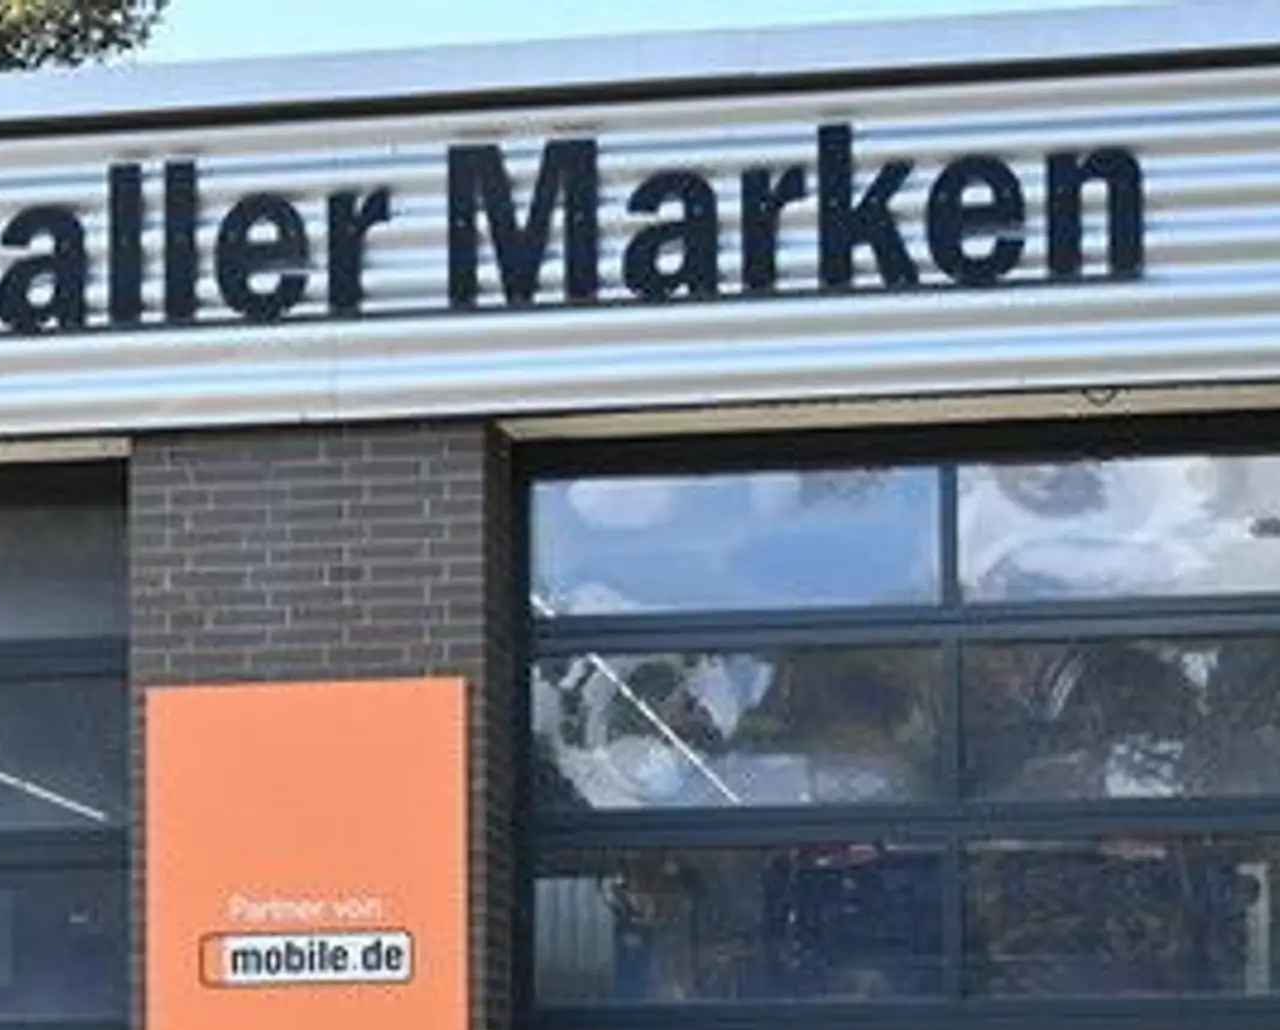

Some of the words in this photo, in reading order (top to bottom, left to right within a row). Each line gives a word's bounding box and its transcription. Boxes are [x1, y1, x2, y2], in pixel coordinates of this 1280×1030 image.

[446, 122, 1146, 312] Marken
[229, 895, 325, 921] Partner
[333, 896, 383, 919] von
[231, 938, 404, 977] mobile.de
